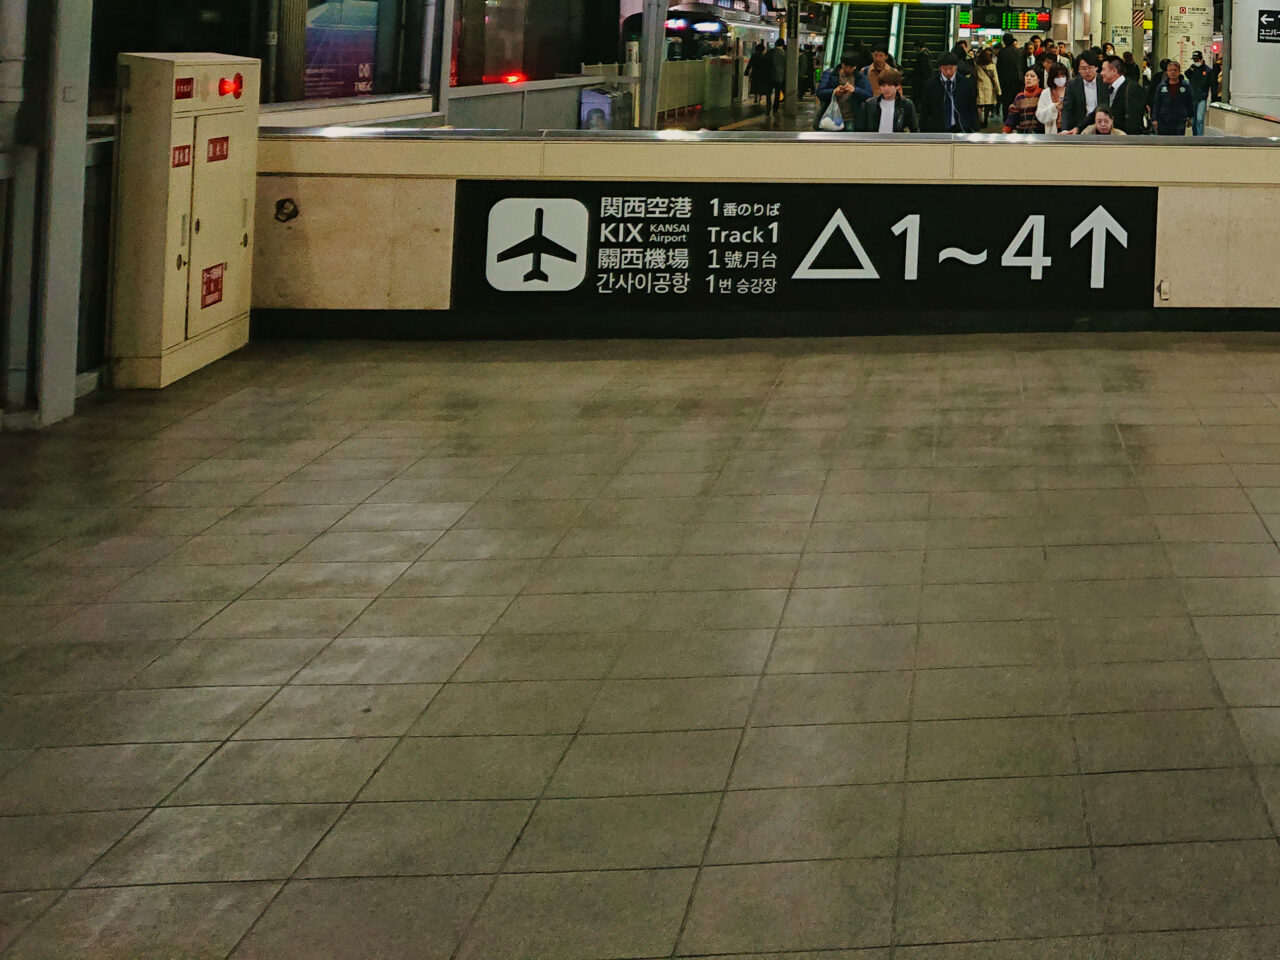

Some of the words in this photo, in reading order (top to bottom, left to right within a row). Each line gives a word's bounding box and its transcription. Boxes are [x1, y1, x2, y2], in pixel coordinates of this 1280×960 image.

[600, 196, 693, 218] 関西空港
[600, 222, 644, 243] KIX
[649, 223, 690, 233] KANSAI
[649, 234, 687, 244] Airport
[597, 248, 690, 269] 關西機場
[596, 272, 691, 293] 간사이공항
[736, 278, 778, 294] 승강장
